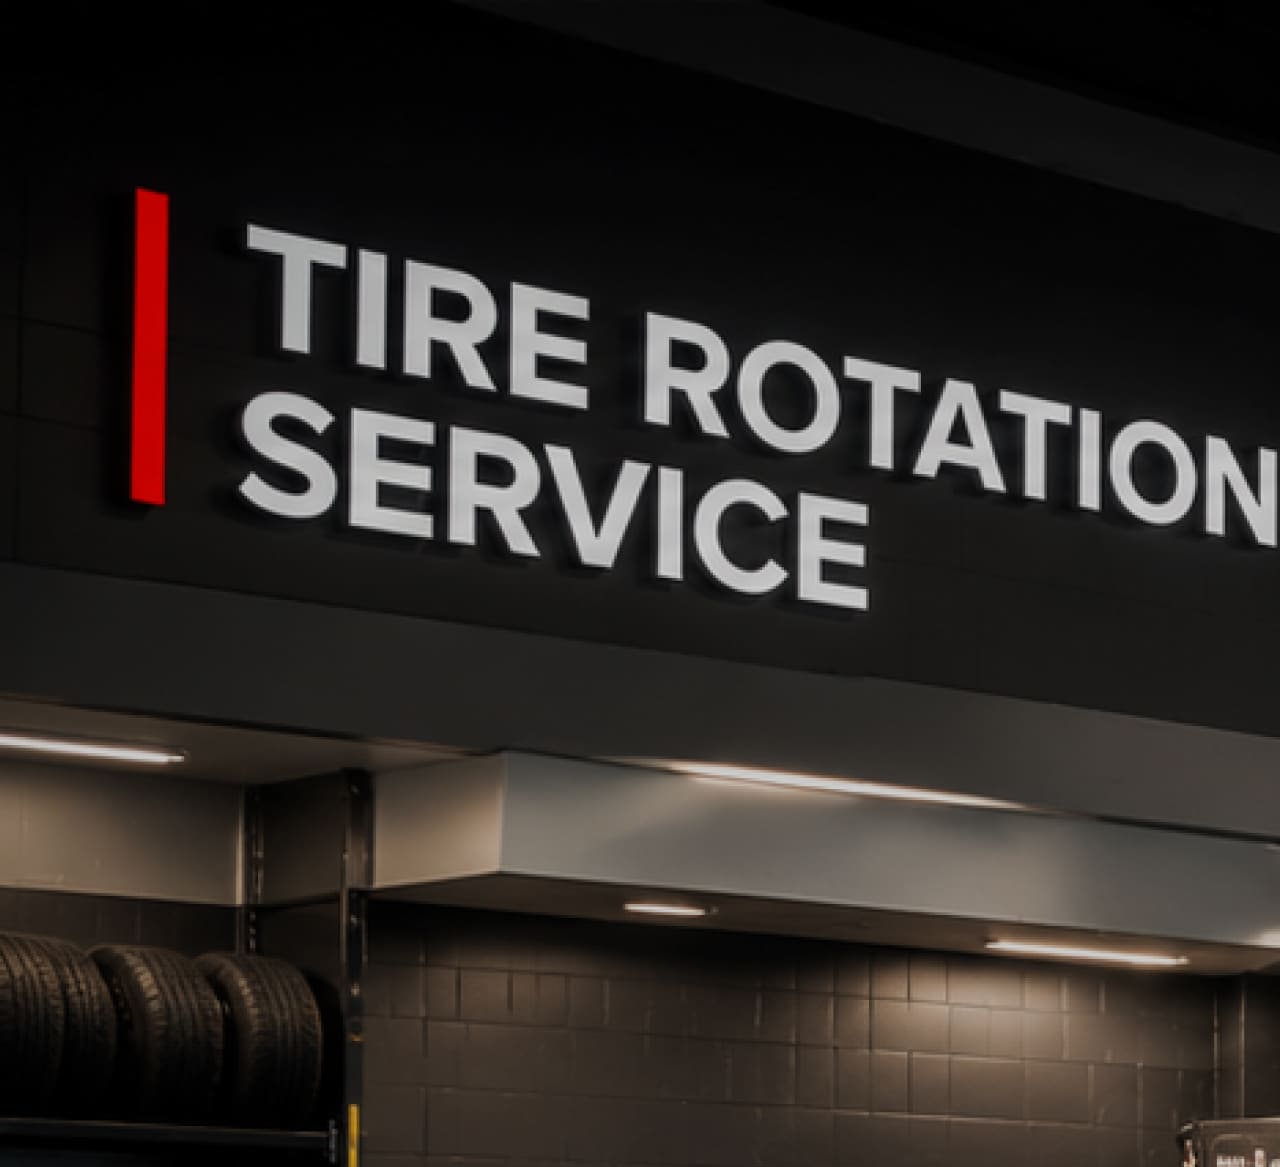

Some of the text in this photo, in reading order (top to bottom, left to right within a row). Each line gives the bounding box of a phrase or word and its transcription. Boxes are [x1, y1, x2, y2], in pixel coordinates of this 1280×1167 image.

[237, 390, 870, 611] SERVICE
[246, 223, 1279, 547] TIRE ROTATION
